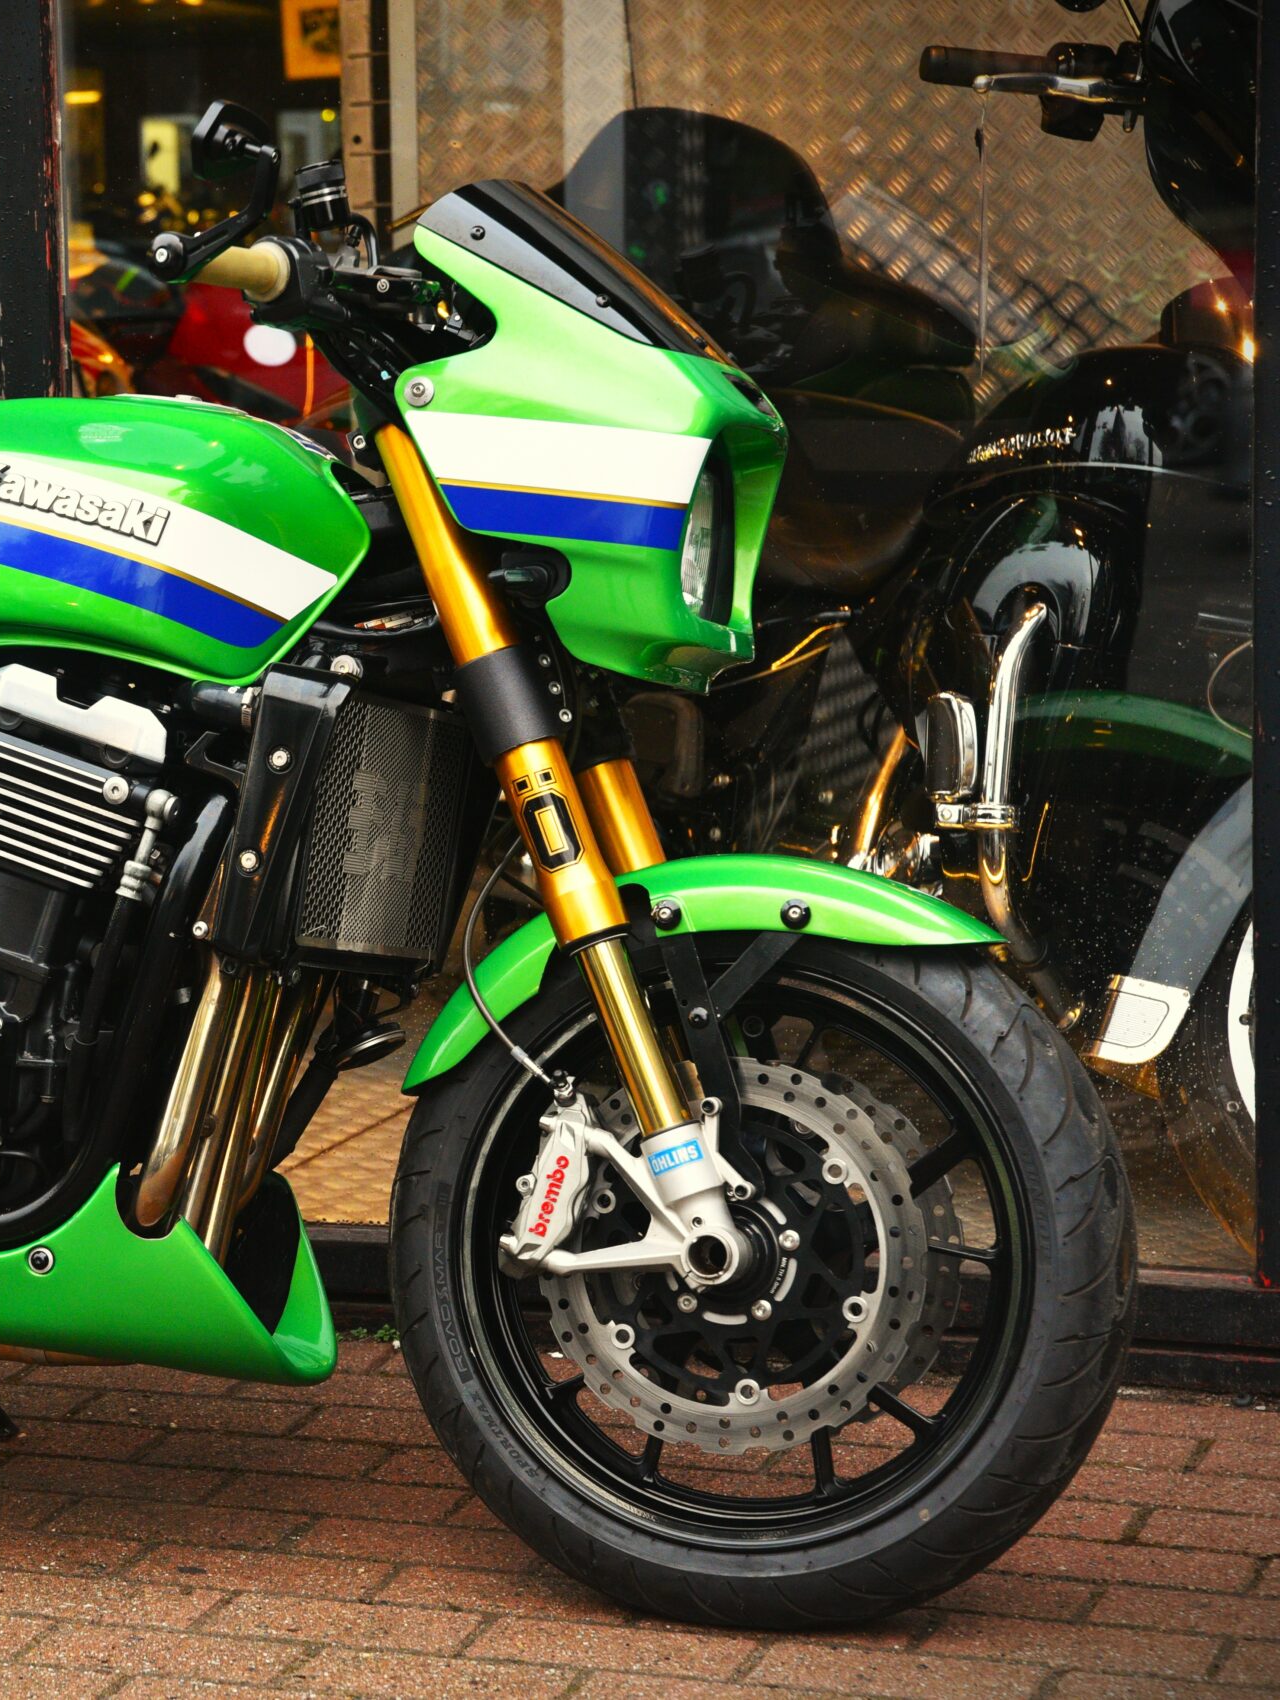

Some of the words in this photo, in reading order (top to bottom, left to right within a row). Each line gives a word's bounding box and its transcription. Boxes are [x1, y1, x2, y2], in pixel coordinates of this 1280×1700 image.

[528, 1154, 571, 1239] brembo
[650, 1143, 700, 1174] ÖHLINS
[433, 1215, 469, 1375] ROADSMART
